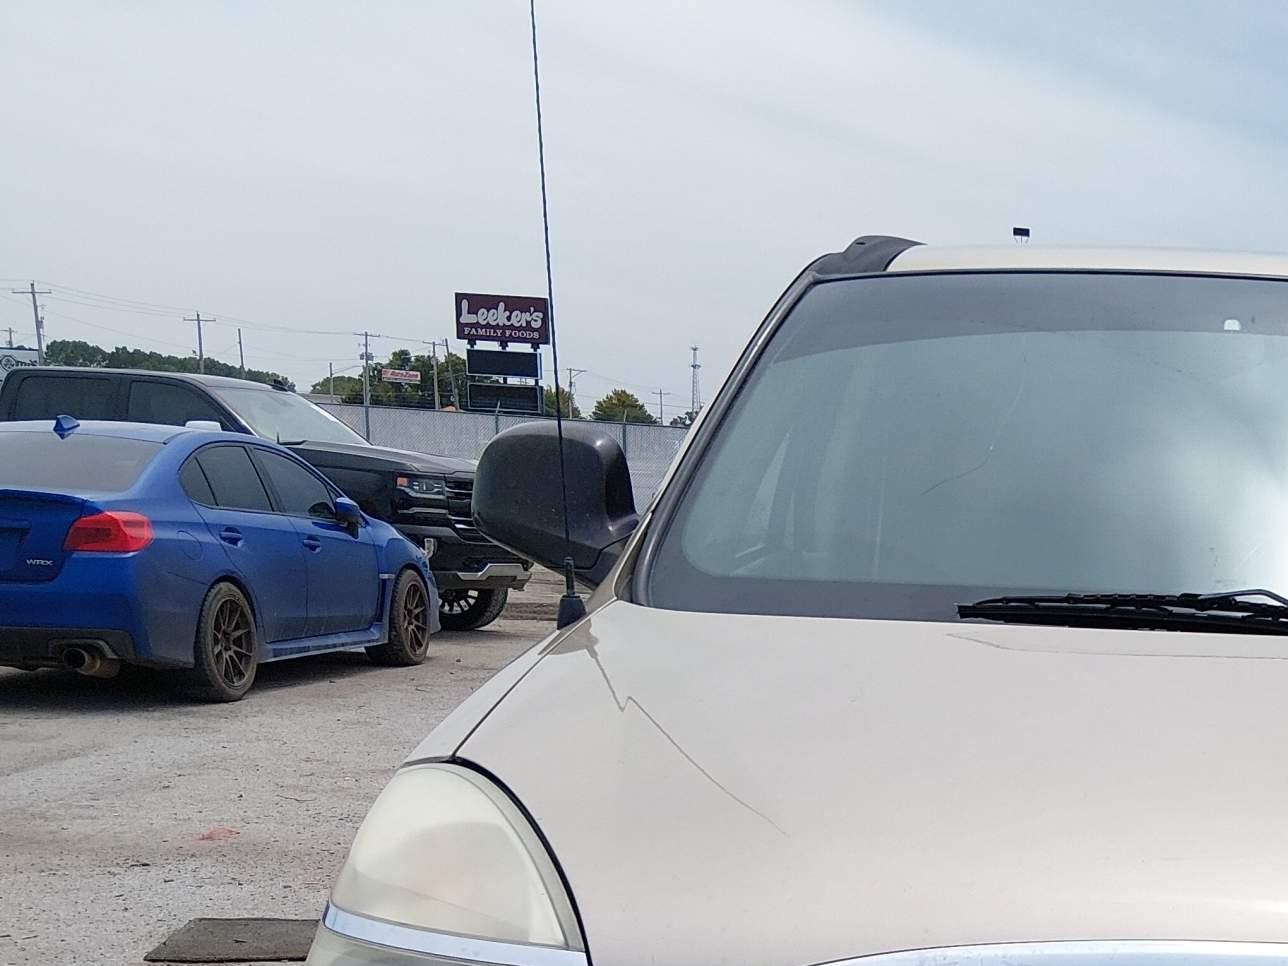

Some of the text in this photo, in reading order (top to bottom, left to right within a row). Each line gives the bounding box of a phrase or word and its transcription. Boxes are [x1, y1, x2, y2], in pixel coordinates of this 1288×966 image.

[459, 299, 544, 329] Leeker's
[464, 327, 540, 339] FAMILY FOODS
